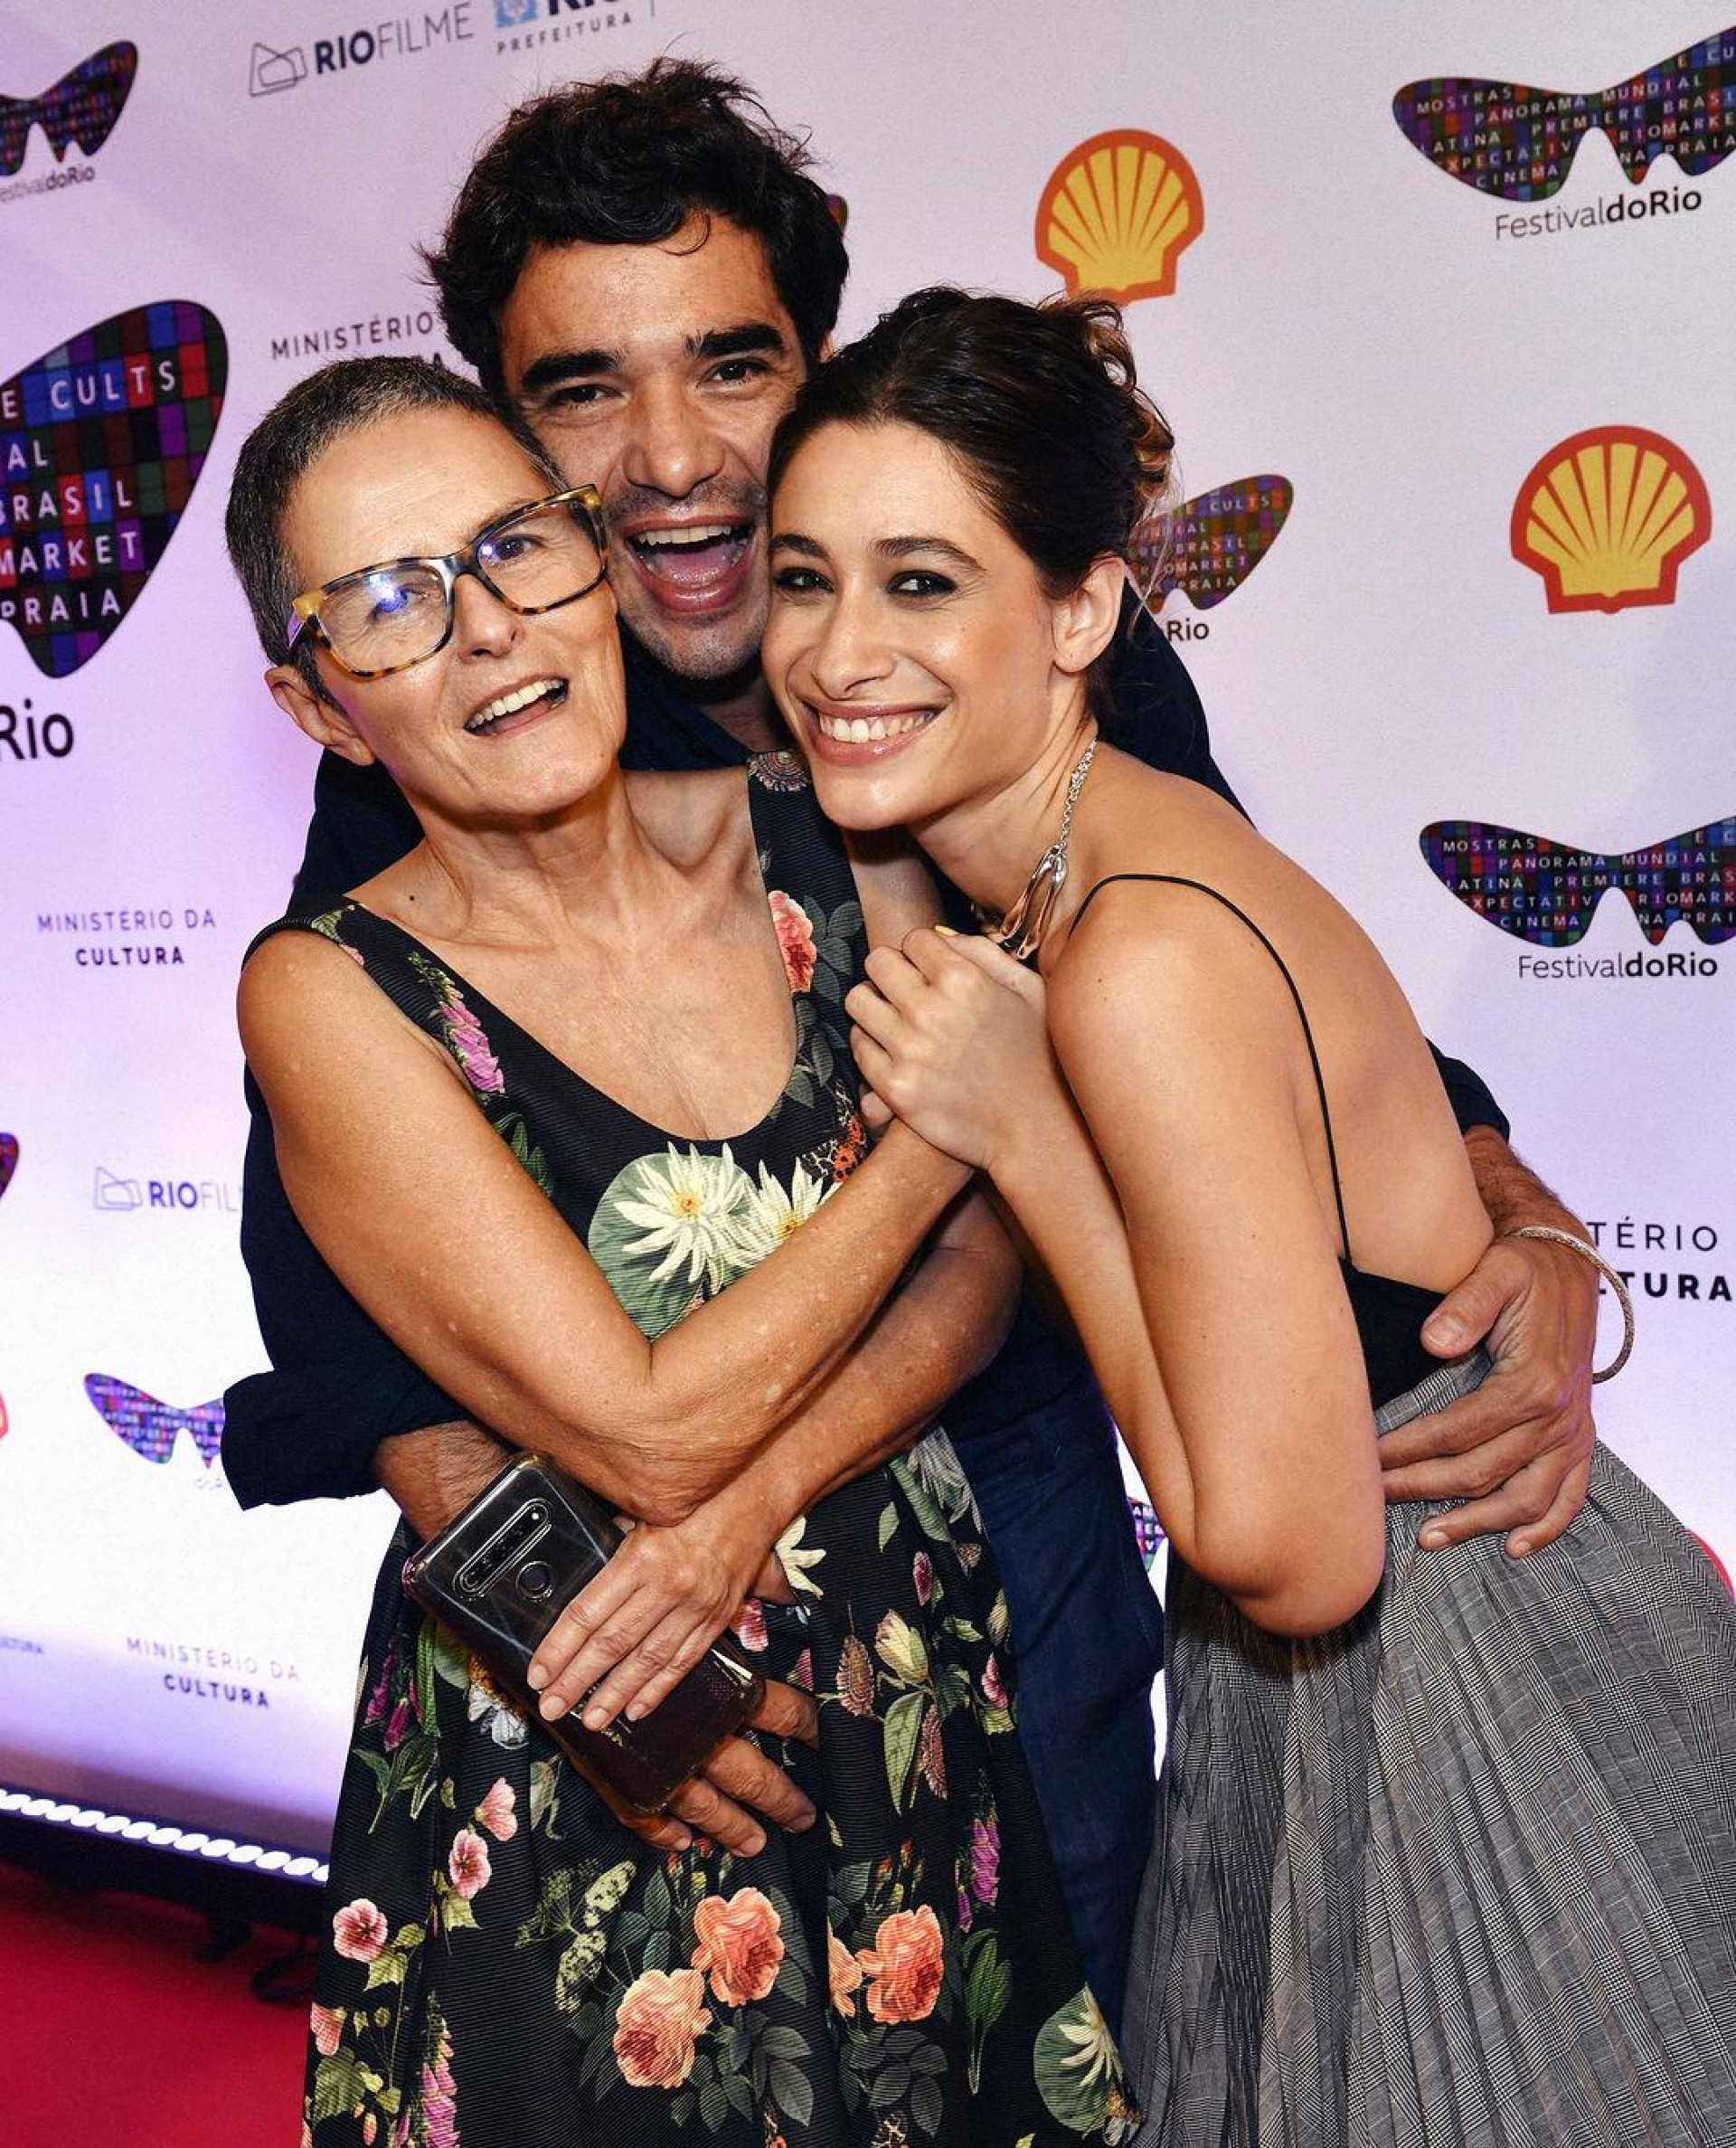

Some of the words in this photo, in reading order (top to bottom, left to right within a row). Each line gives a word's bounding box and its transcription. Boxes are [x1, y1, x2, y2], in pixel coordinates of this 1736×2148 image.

[314, 3, 475, 75] RIOFILME
[497, 12, 631, 54] PREFEITURA
[1417, 87, 1512, 114] MOSTRAS
[1475, 96, 1586, 125] PANORAMA
[1602, 73, 1701, 101] MUNDIAL
[1531, 105, 1645, 137] PREMIERE
[1476, 165, 1560, 189] CINEMA
[1619, 149, 1646, 164] NA
[1495, 186, 1702, 240] FestivaldoRio
[271, 312, 433, 360] MINISTÉRIO
[51, 360, 176, 411] CULTS
[8, 440, 49, 470] AL
[1211, 496, 1269, 512] CULTS
[0, 588, 121, 625] PRAIA
[1443, 838, 1535, 853] MOSTRAS
[1499, 855, 1606, 869] PANORAMA
[1622, 852, 1718, 866] MUNDIAL
[1554, 873, 1661, 886] PREMIERE
[184, 908, 217, 930] DA
[1500, 914, 1580, 928] CINEMA
[1638, 913, 1664, 924] NA
[76, 946, 185, 967] CULTURA
[1518, 951, 1718, 979] FestivaldoRio
[148, 1180, 242, 1212] RIOFIL
[1586, 1216, 1718, 1252] TÉRIO
[1599, 1271, 1732, 1301] TURA
[270, 1660, 299, 1681] DA
[164, 1673, 269, 1708] CULTURA
